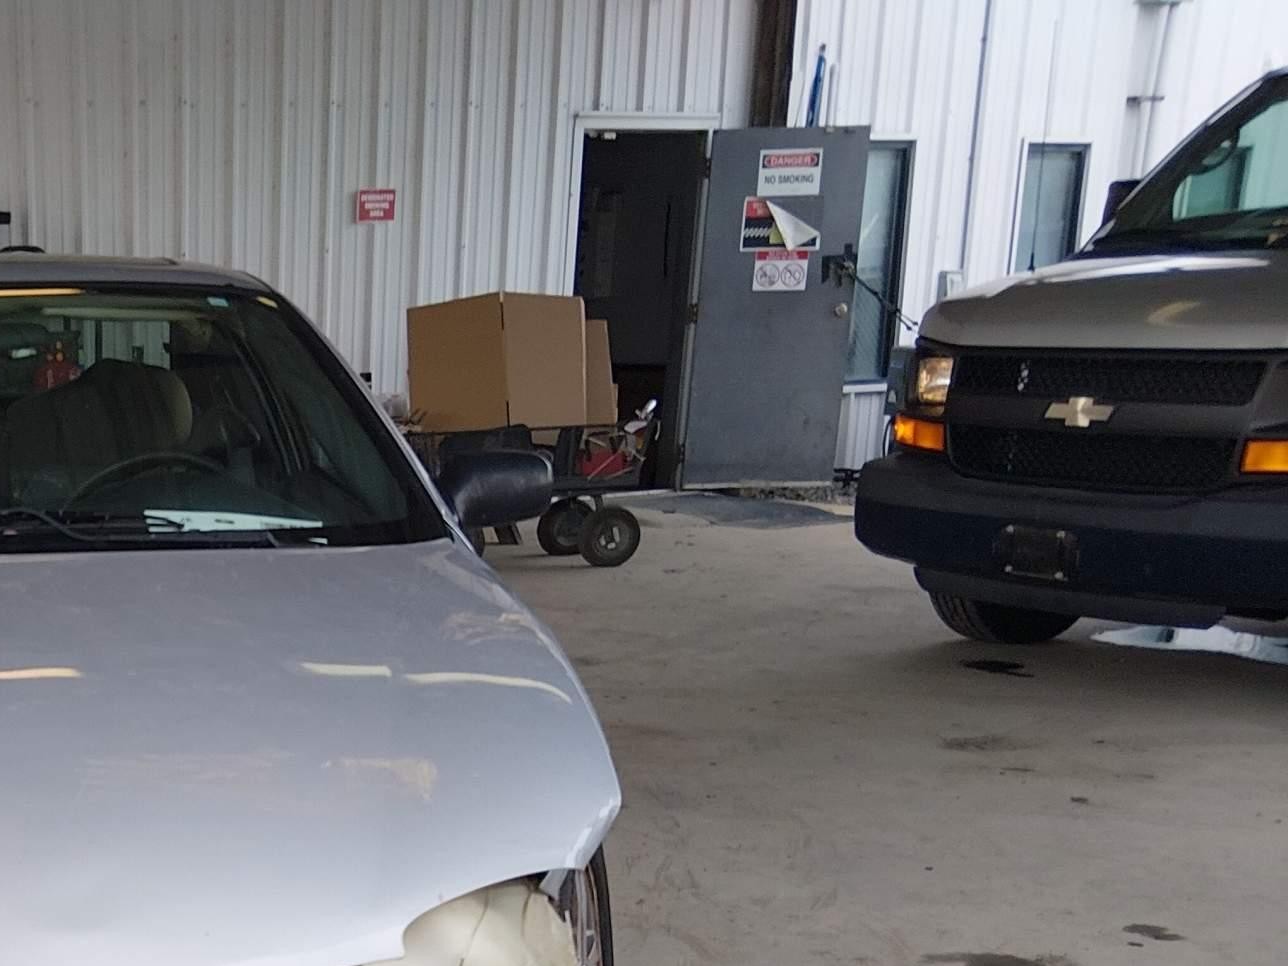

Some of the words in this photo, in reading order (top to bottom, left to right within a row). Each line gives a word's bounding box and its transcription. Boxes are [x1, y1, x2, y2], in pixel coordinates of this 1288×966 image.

[771, 155, 811, 166] DANGER
[764, 174, 776, 184] NO
[778, 173, 814, 184] SMOKING
